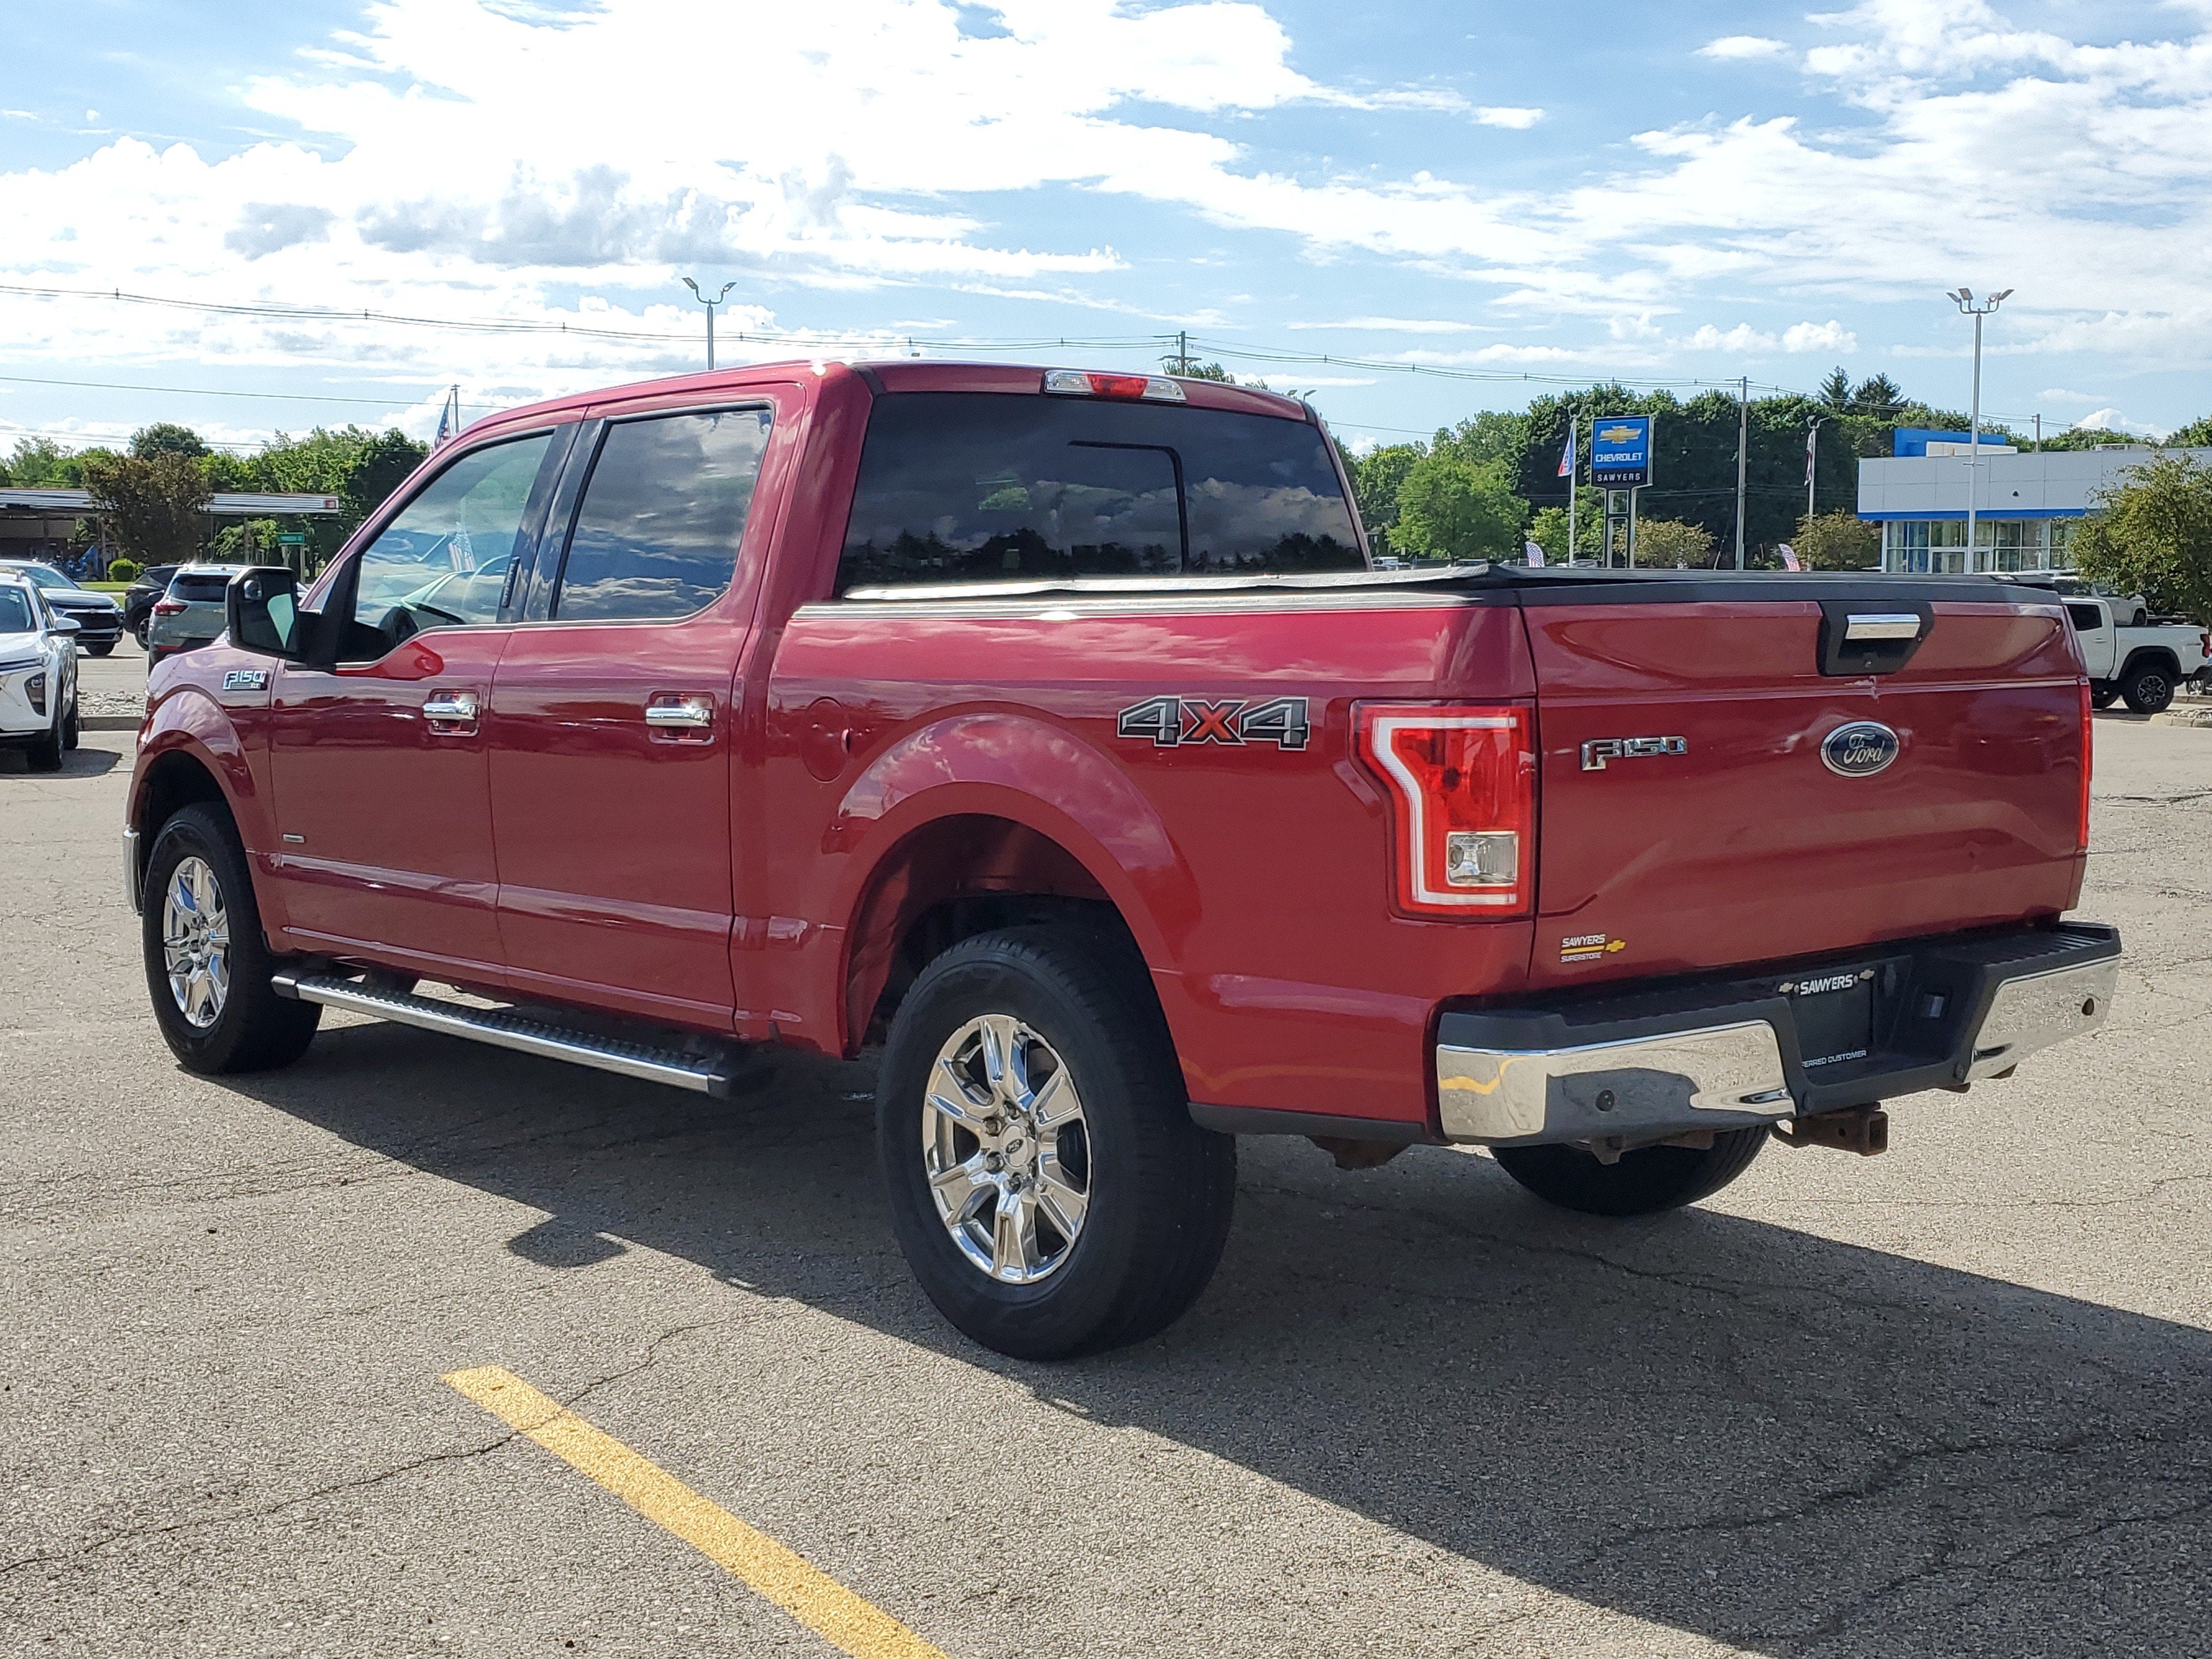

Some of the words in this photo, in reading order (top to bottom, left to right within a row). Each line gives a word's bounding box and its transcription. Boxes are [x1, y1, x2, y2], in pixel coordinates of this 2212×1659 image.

[1595, 452, 1643, 462] CHEVROLET
[1596, 473, 1641, 482] SAWYERS
[1843, 733, 1886, 765] Ford
[1561, 934, 1606, 948] SAWYERS
[1560, 952, 1602, 963] SUPERSTORE
[1800, 974, 1854, 996] SAWYERS
[1827, 1049, 1867, 1063] CUSTOMER
